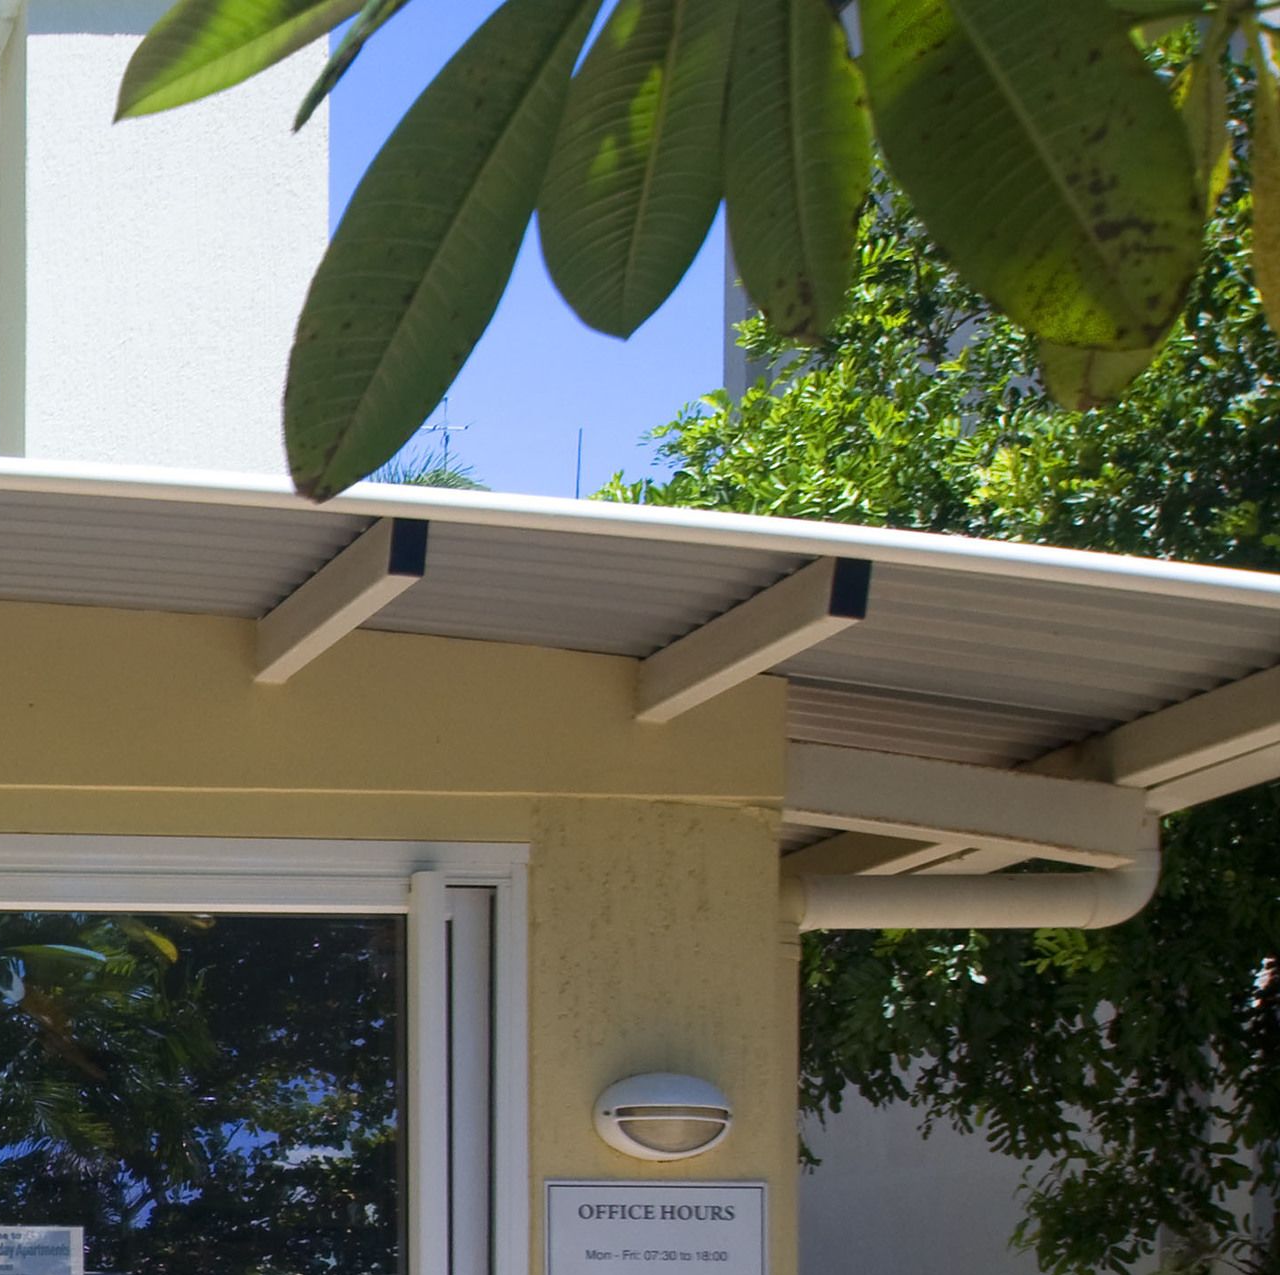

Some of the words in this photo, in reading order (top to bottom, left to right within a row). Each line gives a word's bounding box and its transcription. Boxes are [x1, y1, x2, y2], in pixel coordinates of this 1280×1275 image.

[578, 1204, 655, 1221] OFFICE
[660, 1205, 736, 1221] HOURS
[10, 1231, 22, 1240] to
[16, 1244, 70, 1259] Apartments
[585, 1249, 612, 1260] Mon
[643, 1250, 677, 1261] 07:30
[680, 1251, 692, 1261] to
